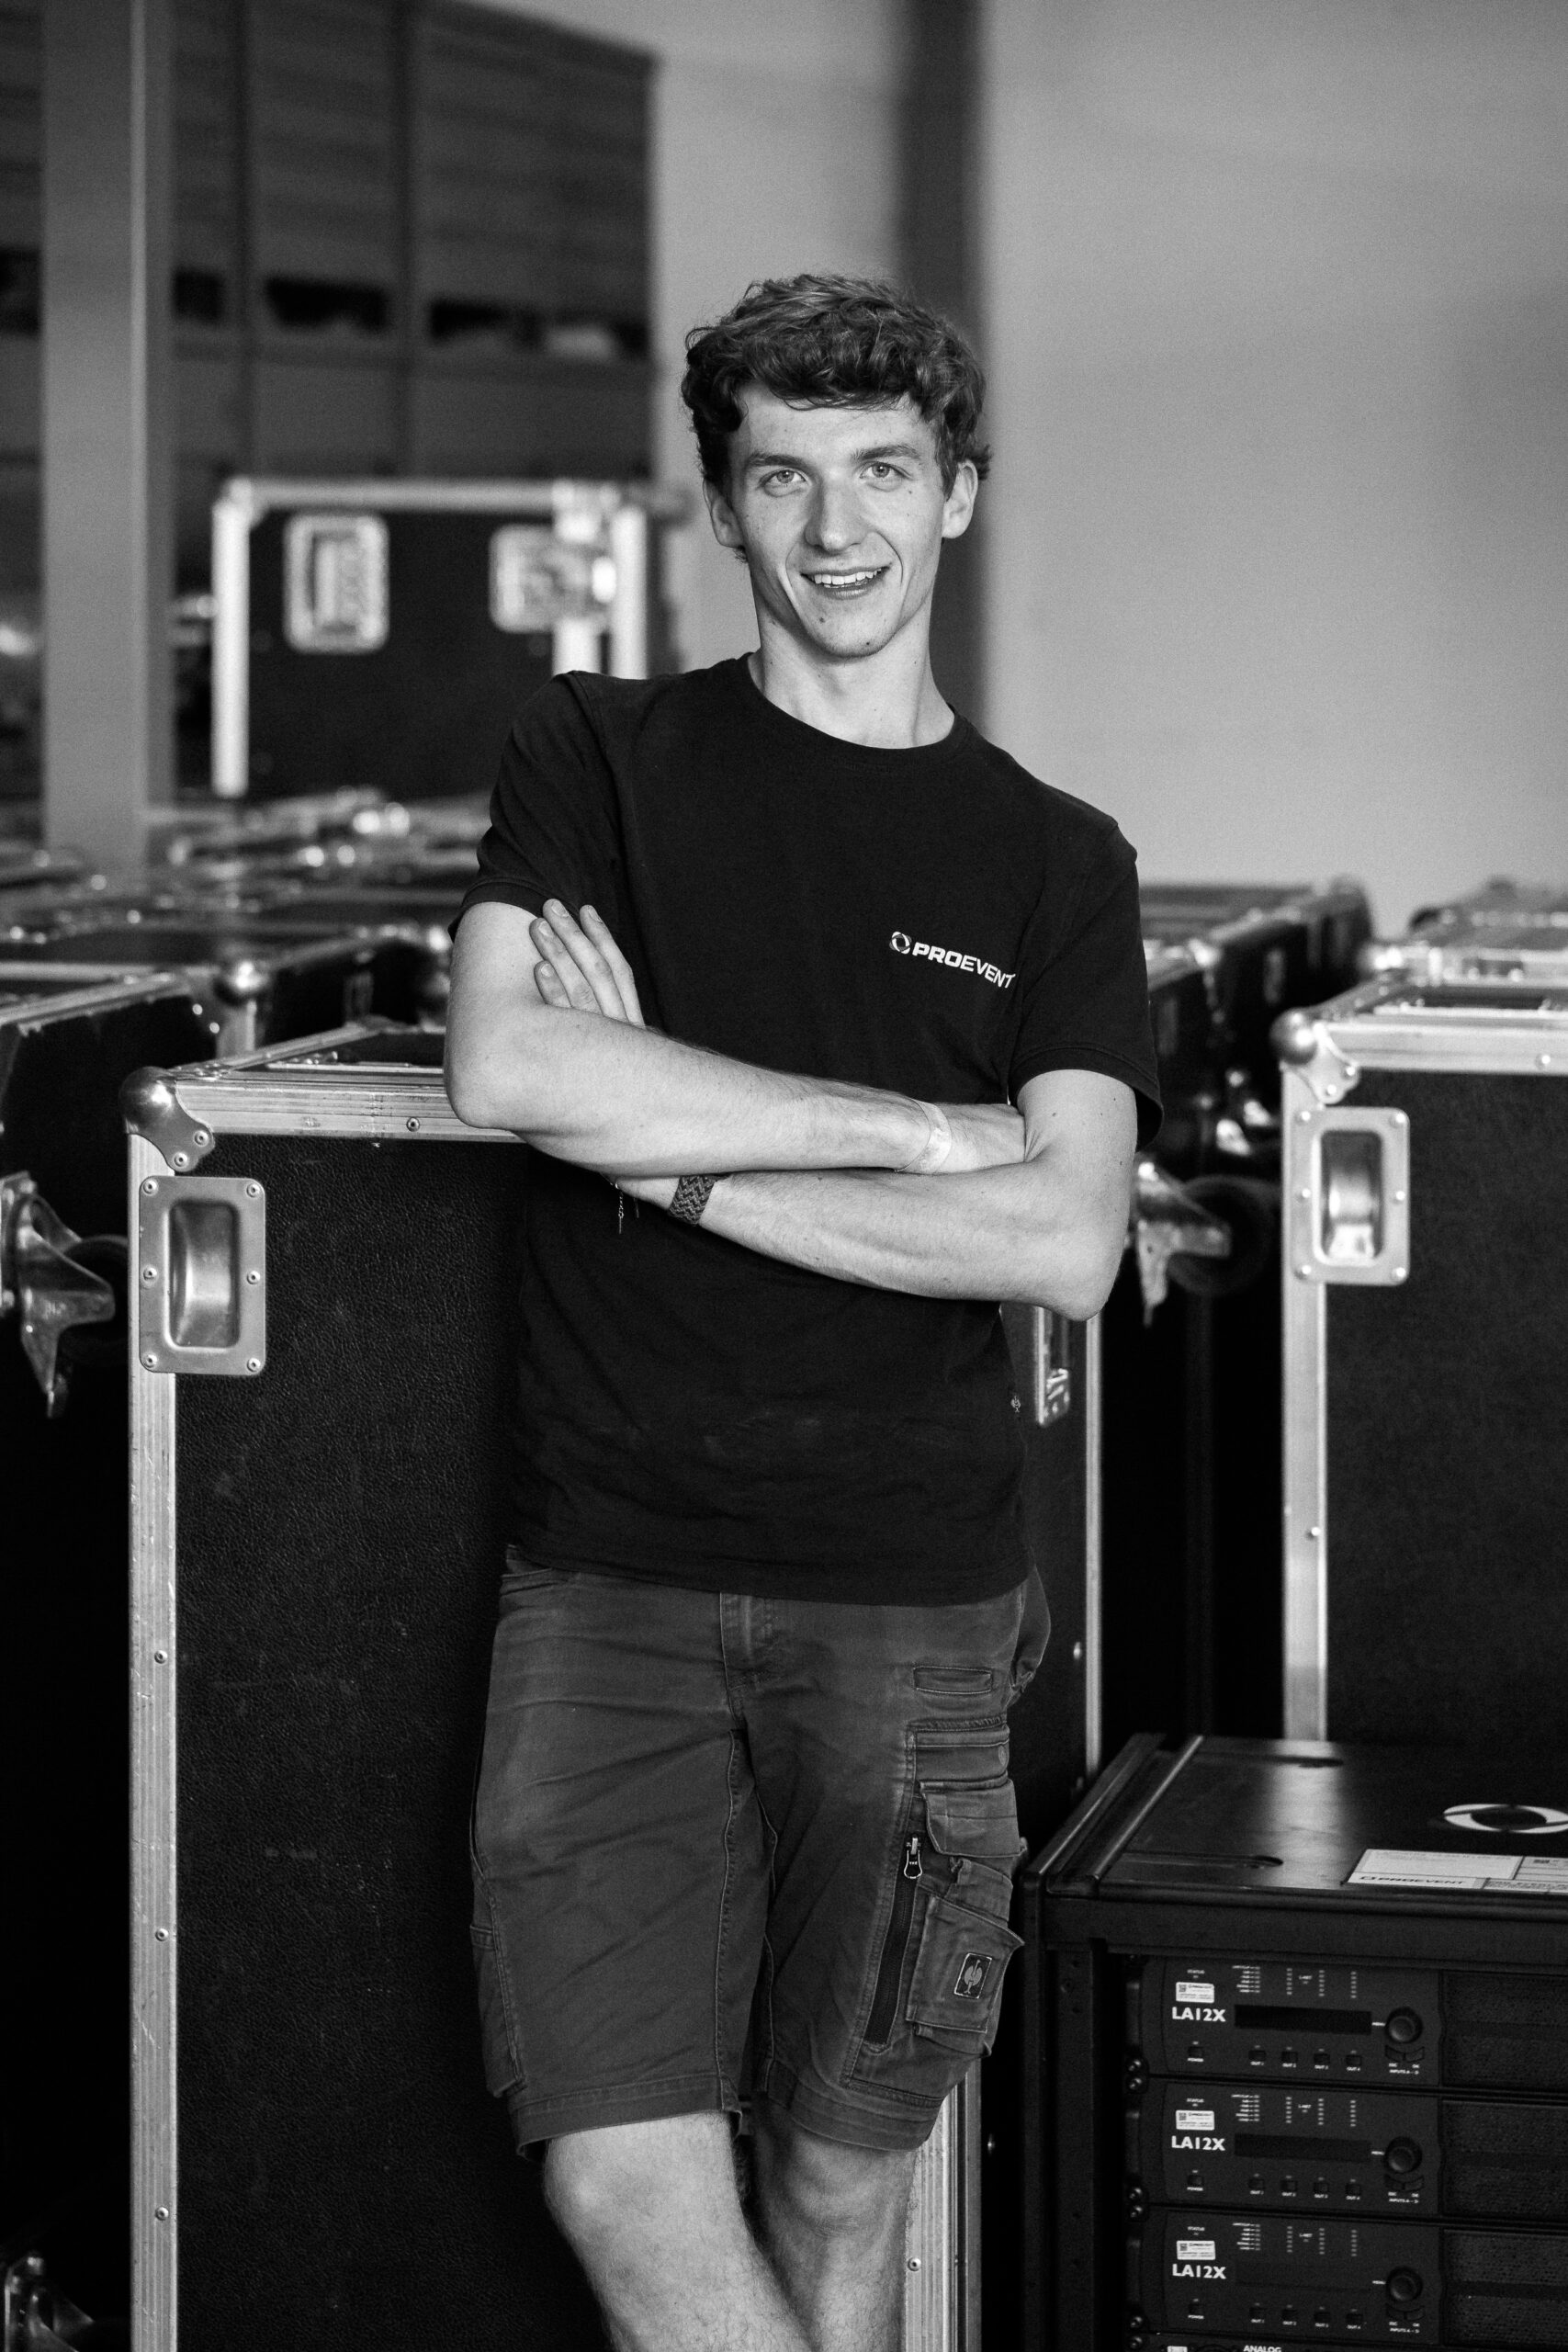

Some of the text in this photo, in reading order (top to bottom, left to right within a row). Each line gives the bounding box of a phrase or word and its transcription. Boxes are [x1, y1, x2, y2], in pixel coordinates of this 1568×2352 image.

[911, 942, 1016, 989] PROEVENT
[1172, 2007, 1225, 2021] LA12X
[1172, 2136, 1224, 2151] LA12X
[1173, 2264, 1225, 2278] LA12X
